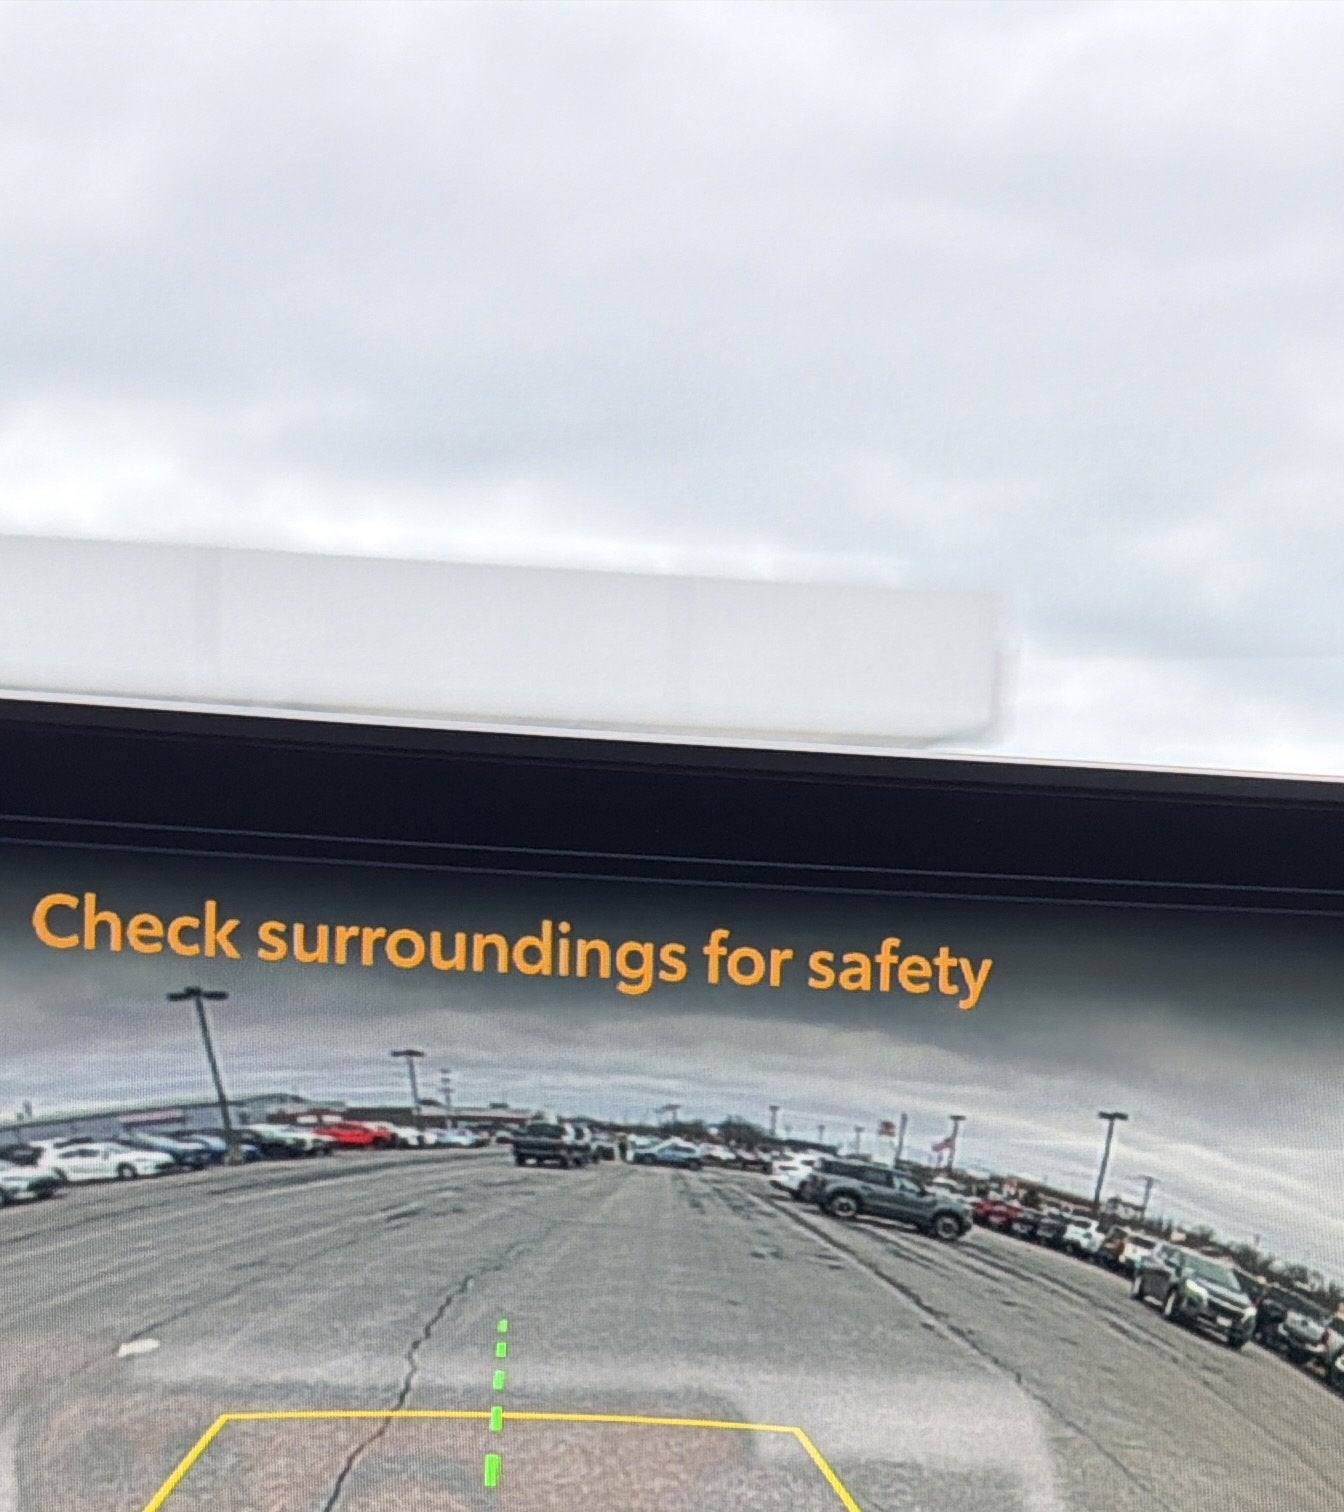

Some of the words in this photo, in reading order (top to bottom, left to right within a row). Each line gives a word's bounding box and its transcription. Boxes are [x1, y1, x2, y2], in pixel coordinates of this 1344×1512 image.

[31, 892, 241, 960] Check
[258, 919, 688, 997] surroundings
[703, 929, 795, 988] for
[808, 936, 993, 1010] safety
